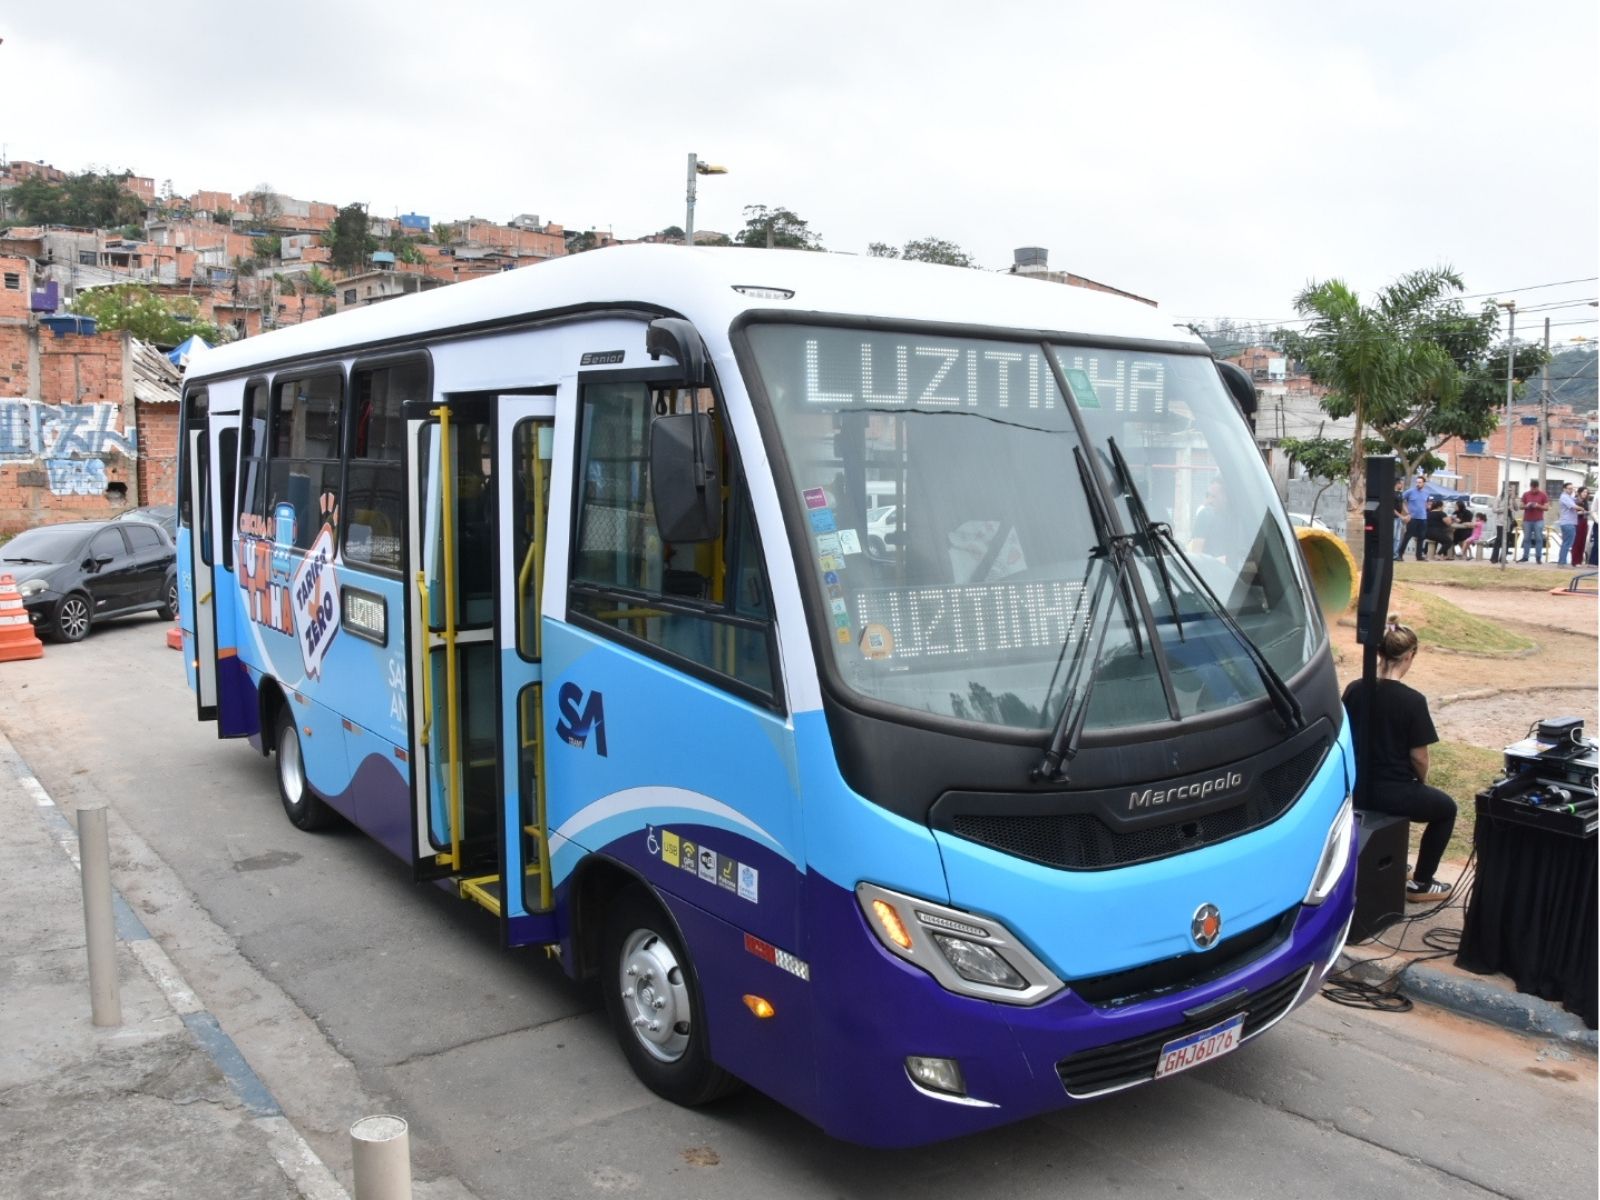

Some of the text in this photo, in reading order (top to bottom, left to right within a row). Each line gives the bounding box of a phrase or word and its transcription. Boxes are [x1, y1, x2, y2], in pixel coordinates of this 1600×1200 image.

[581, 354, 623, 365] Senior
[305, 591, 334, 657] ZERO
[1128, 771, 1243, 810] Marcopolo
[1164, 1031, 1233, 1072] GHJ6D76
